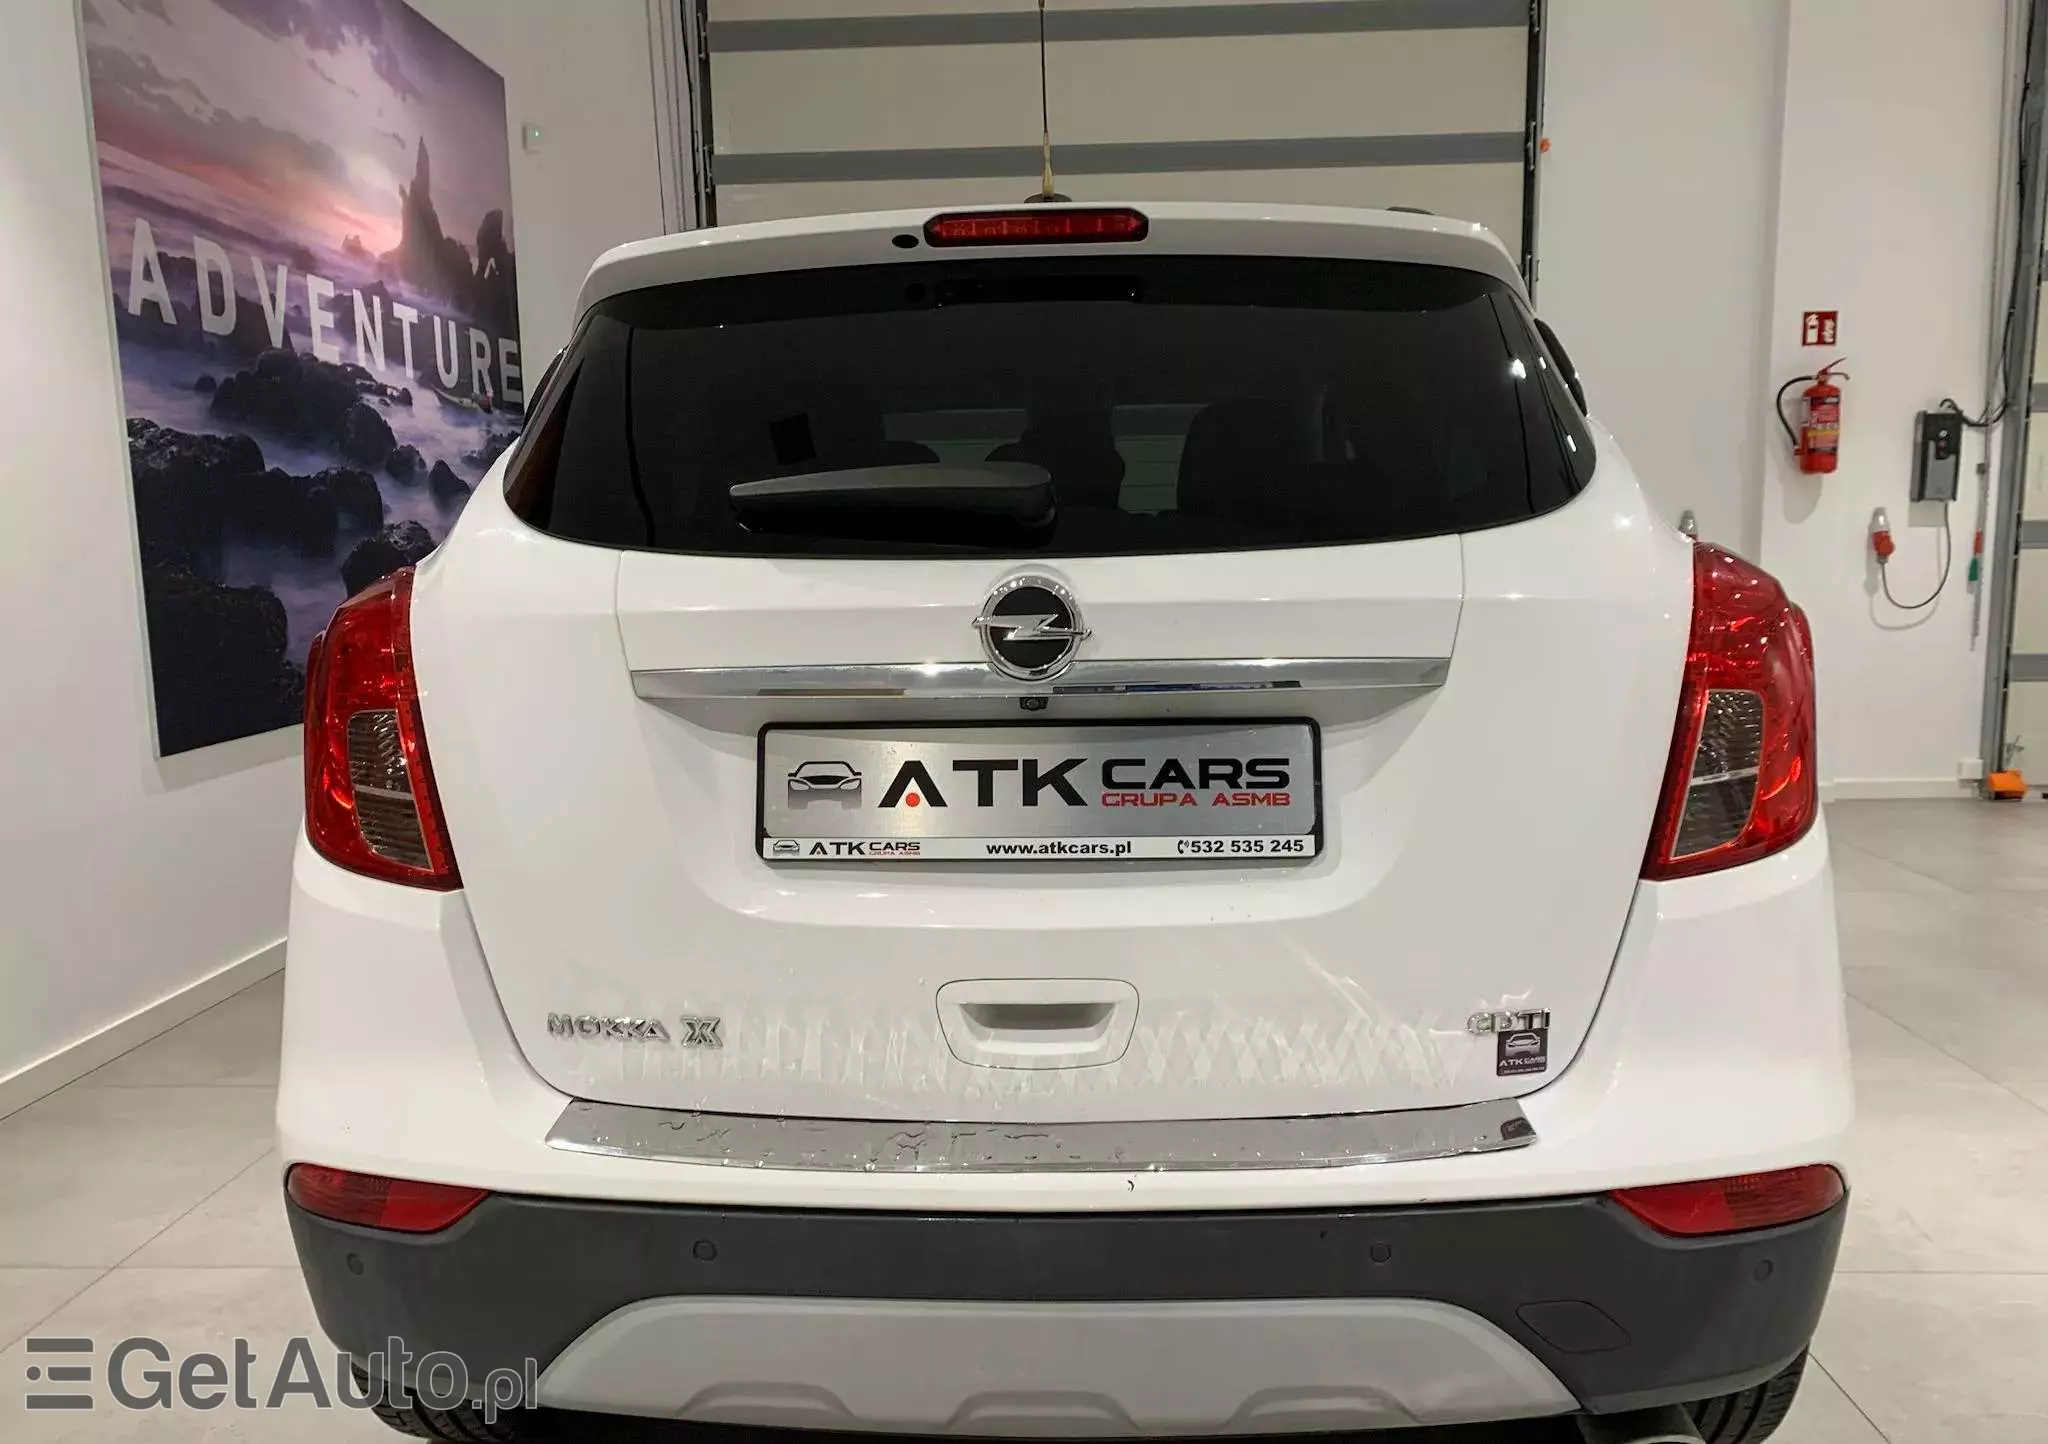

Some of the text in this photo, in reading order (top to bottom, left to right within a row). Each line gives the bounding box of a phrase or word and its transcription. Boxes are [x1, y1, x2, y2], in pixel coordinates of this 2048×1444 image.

[128, 217, 523, 404] ADVENTURE
[878, 757, 1291, 808] ATK CARS
[1101, 792, 1291, 807] GRUPA ASMB
[809, 841, 921, 856] ATK CARS
[986, 840, 1132, 857] www.atkcars.pl
[1190, 839, 1304, 853] 532 535 245
[547, 1012, 724, 1049] MOKKA X
[1465, 1008, 1551, 1034] CDTI
